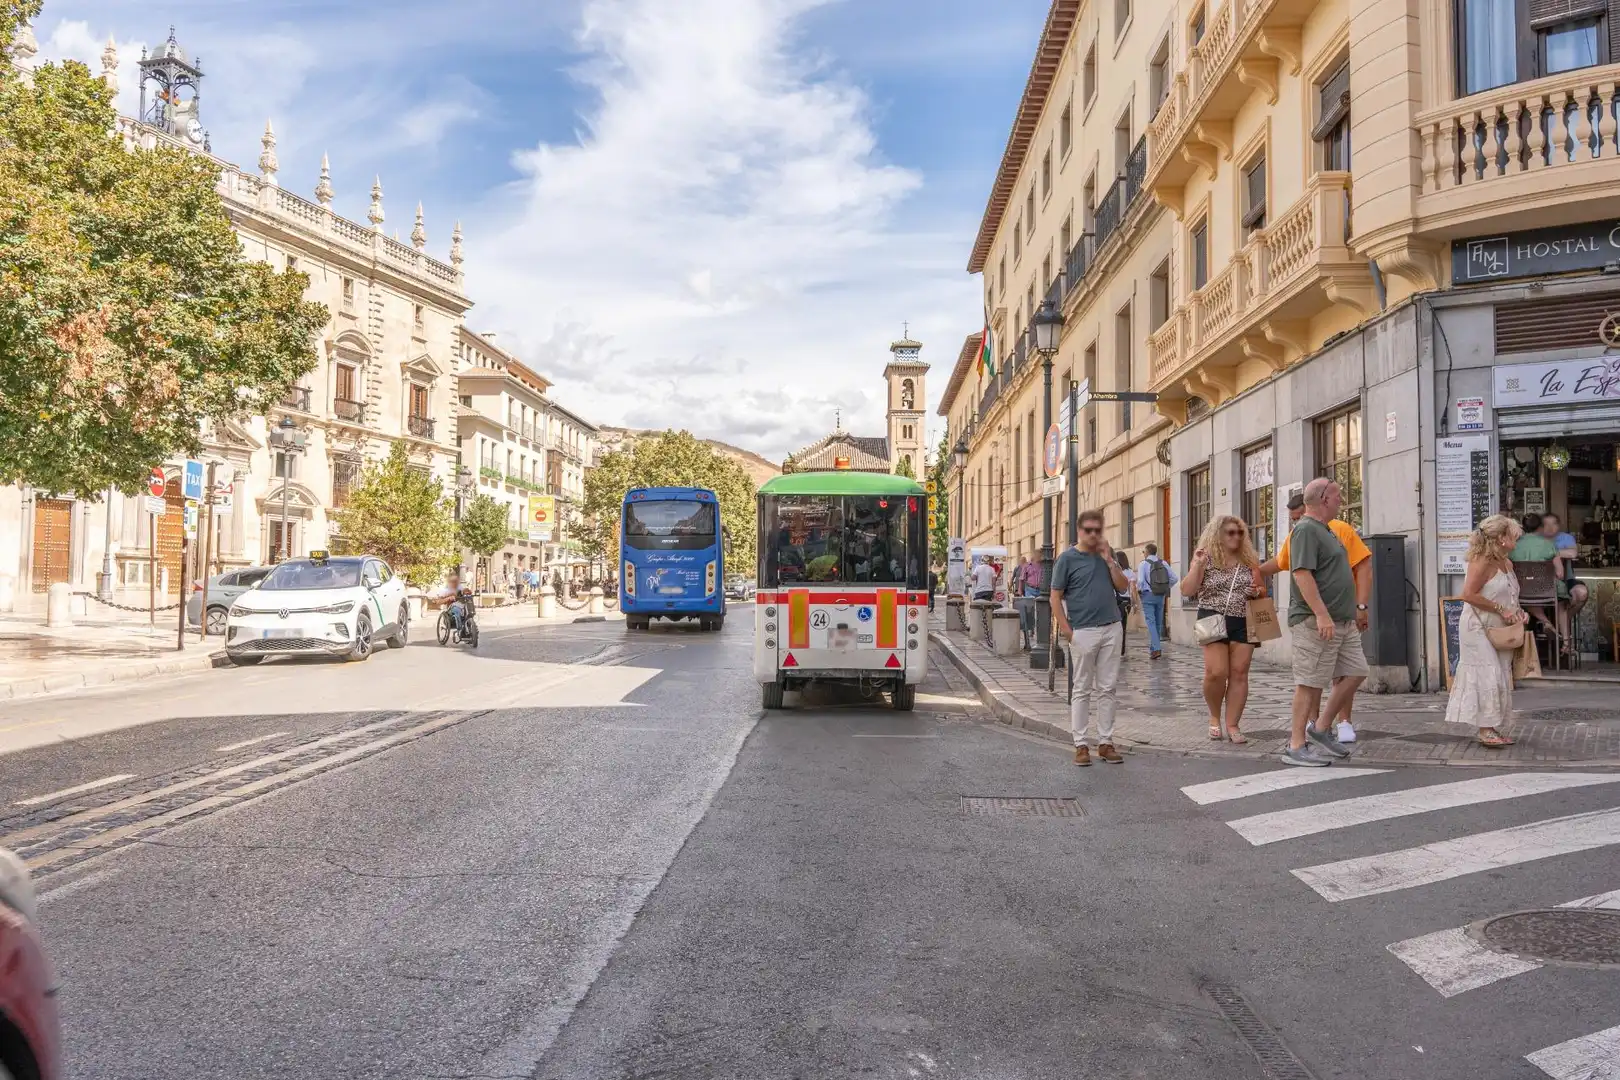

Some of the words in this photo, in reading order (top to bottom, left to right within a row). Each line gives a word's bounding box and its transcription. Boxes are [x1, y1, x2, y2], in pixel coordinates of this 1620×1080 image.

[1516, 236, 1600, 260] HOSTAL
[1539, 368, 1565, 398] La
[813, 613, 827, 627] 24
